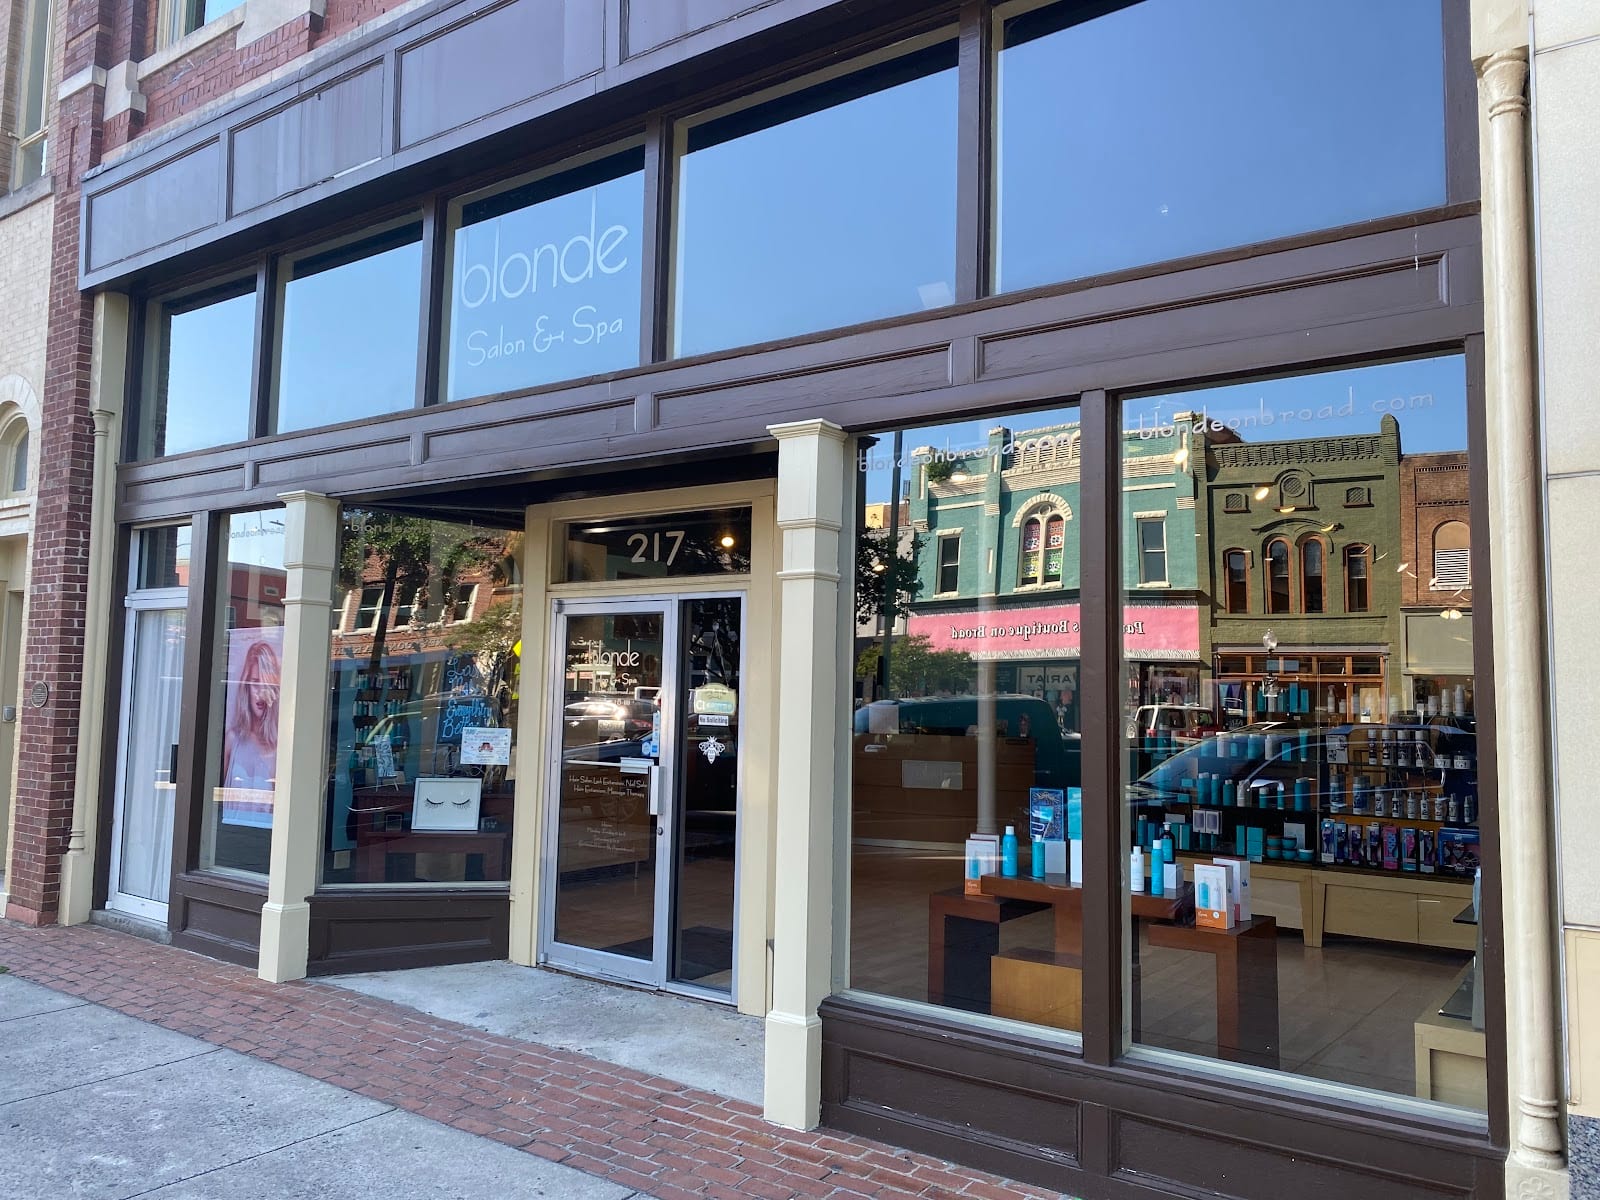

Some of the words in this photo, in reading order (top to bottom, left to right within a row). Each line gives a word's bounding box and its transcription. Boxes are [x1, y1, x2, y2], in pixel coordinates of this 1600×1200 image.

[461, 188, 629, 308] blonde
[467, 325, 525, 367] Salon
[533, 315, 565, 353] &
[572, 305, 623, 344] Spa
[1139, 386, 1434, 440] blondeonbroad.com
[626, 530, 686, 566] 217
[621, 672, 638, 686] Spa
